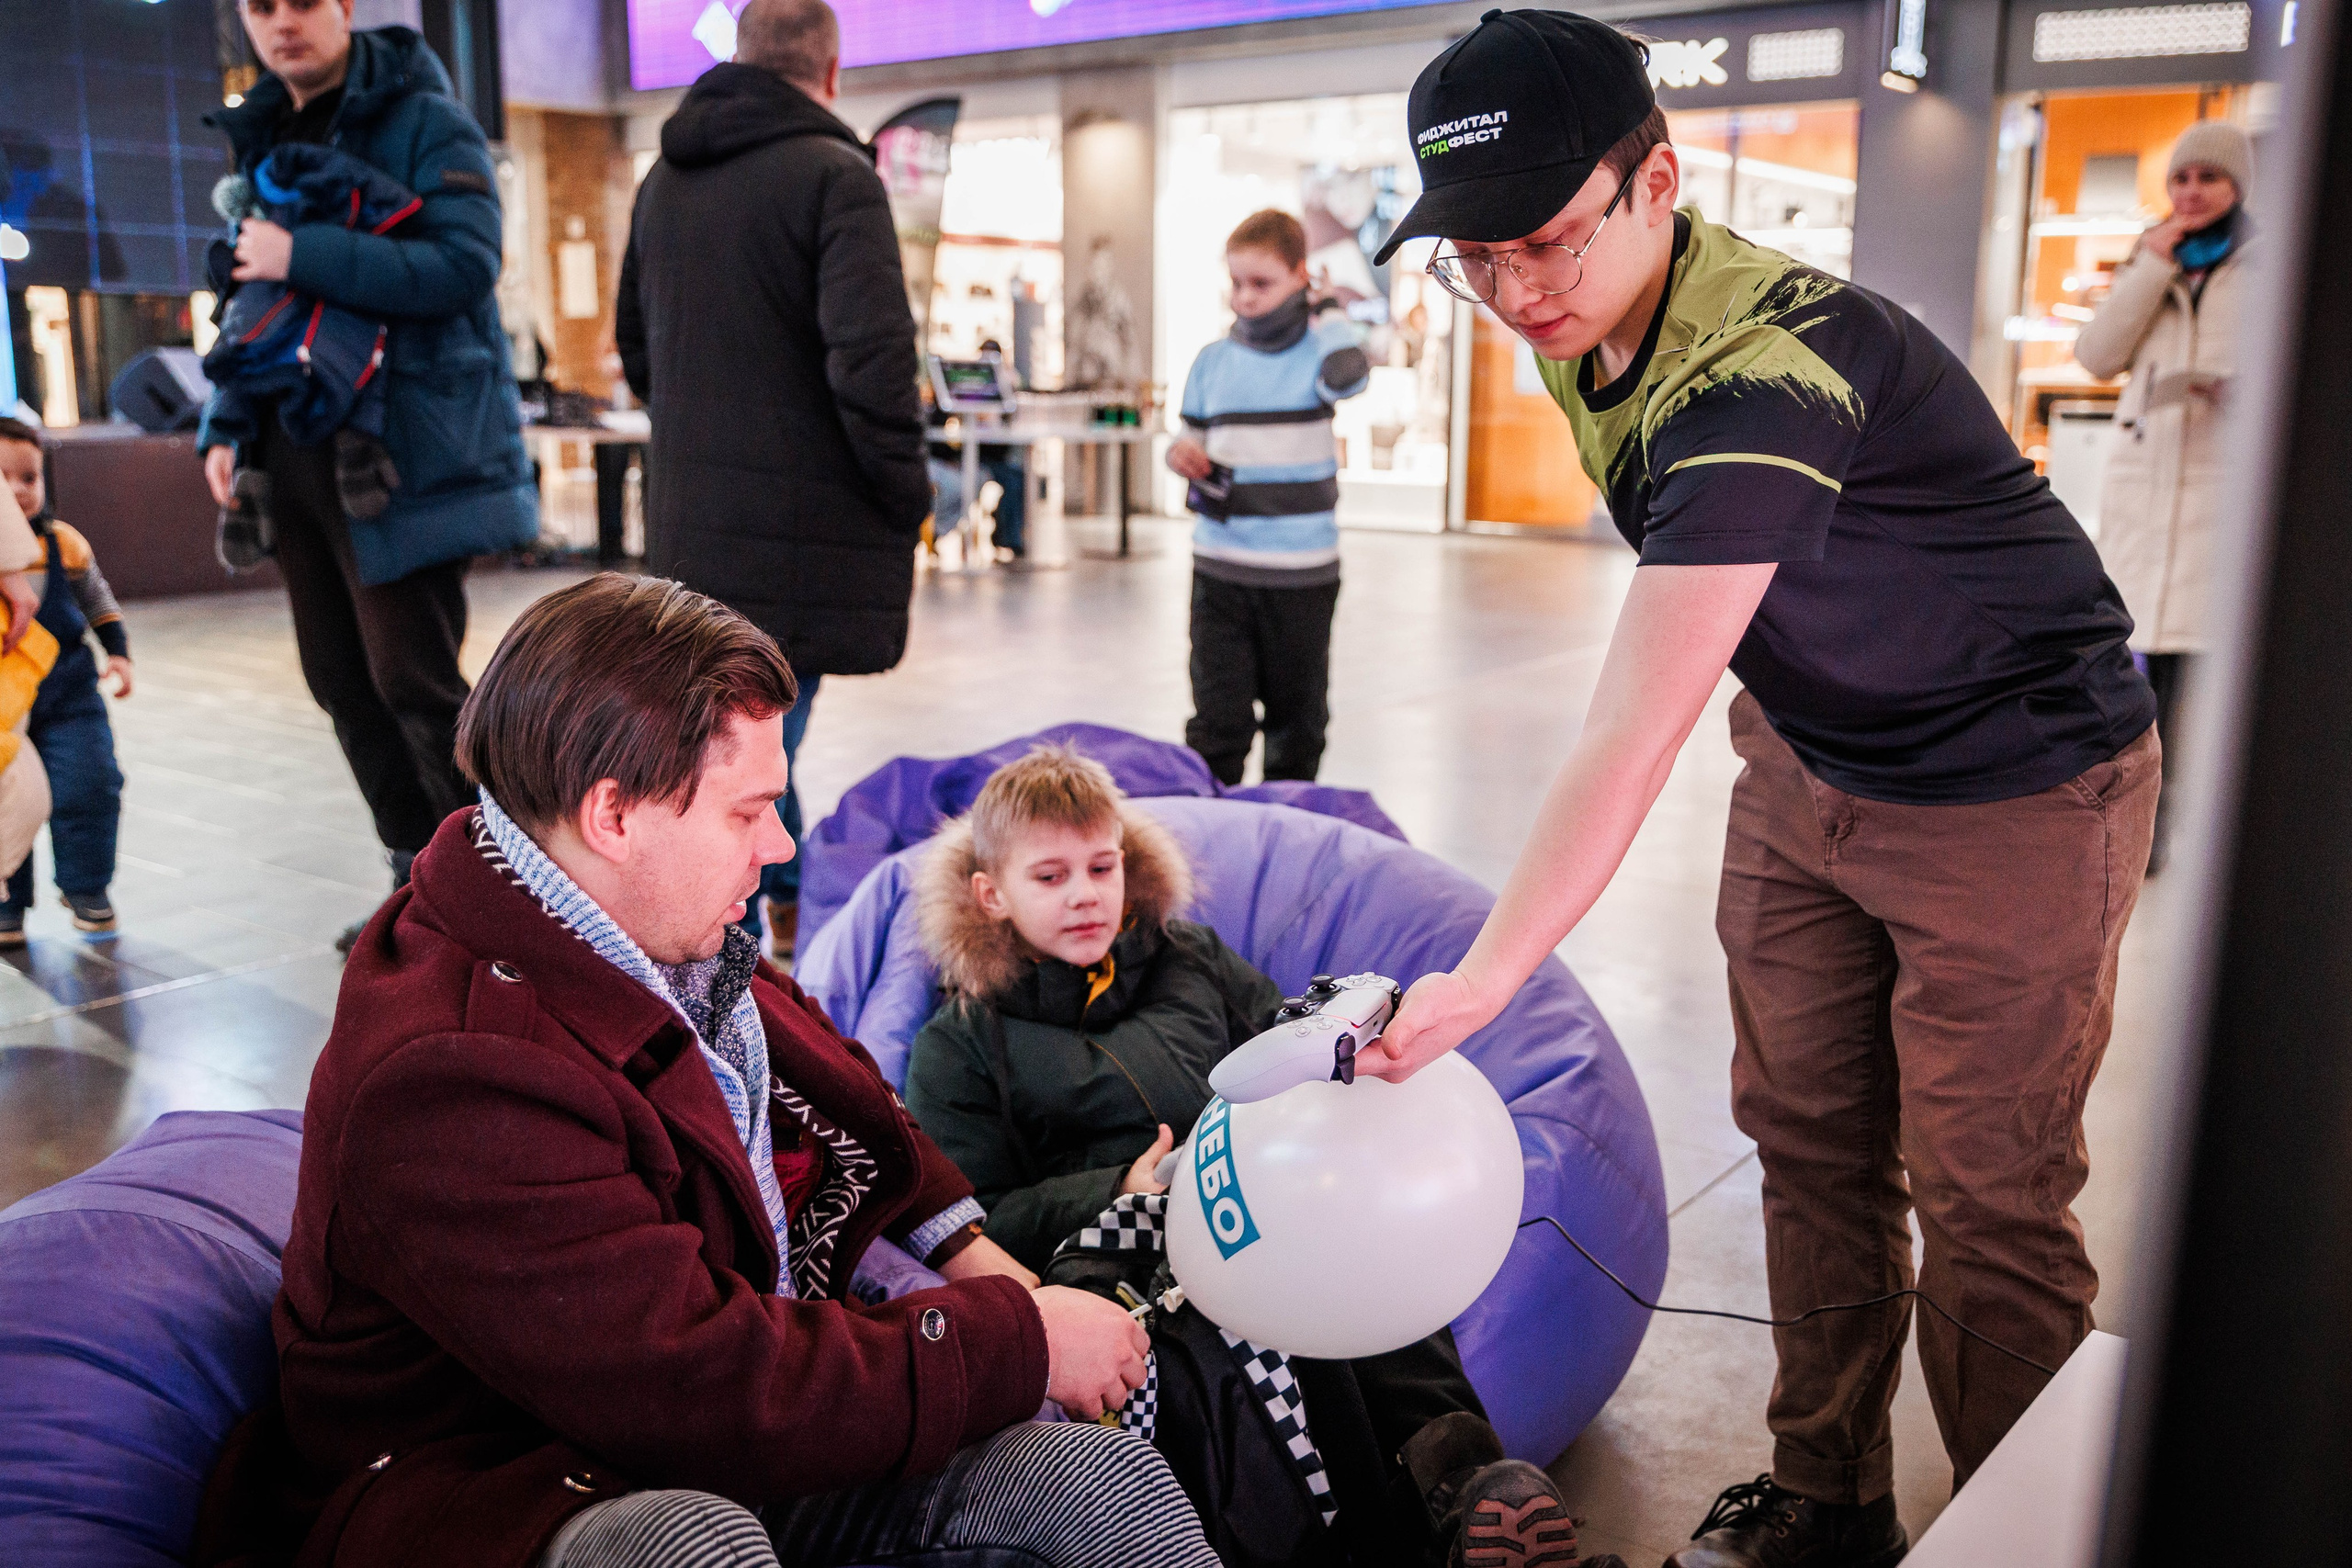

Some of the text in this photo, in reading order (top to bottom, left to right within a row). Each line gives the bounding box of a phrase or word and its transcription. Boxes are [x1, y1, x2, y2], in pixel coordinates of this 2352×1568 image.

[1417, 110, 1508, 145] ФИДЖИТАЛ
[1420, 127, 1502, 159] СТУДФЕСТ
[1198, 1096, 1245, 1245] НЕБО
